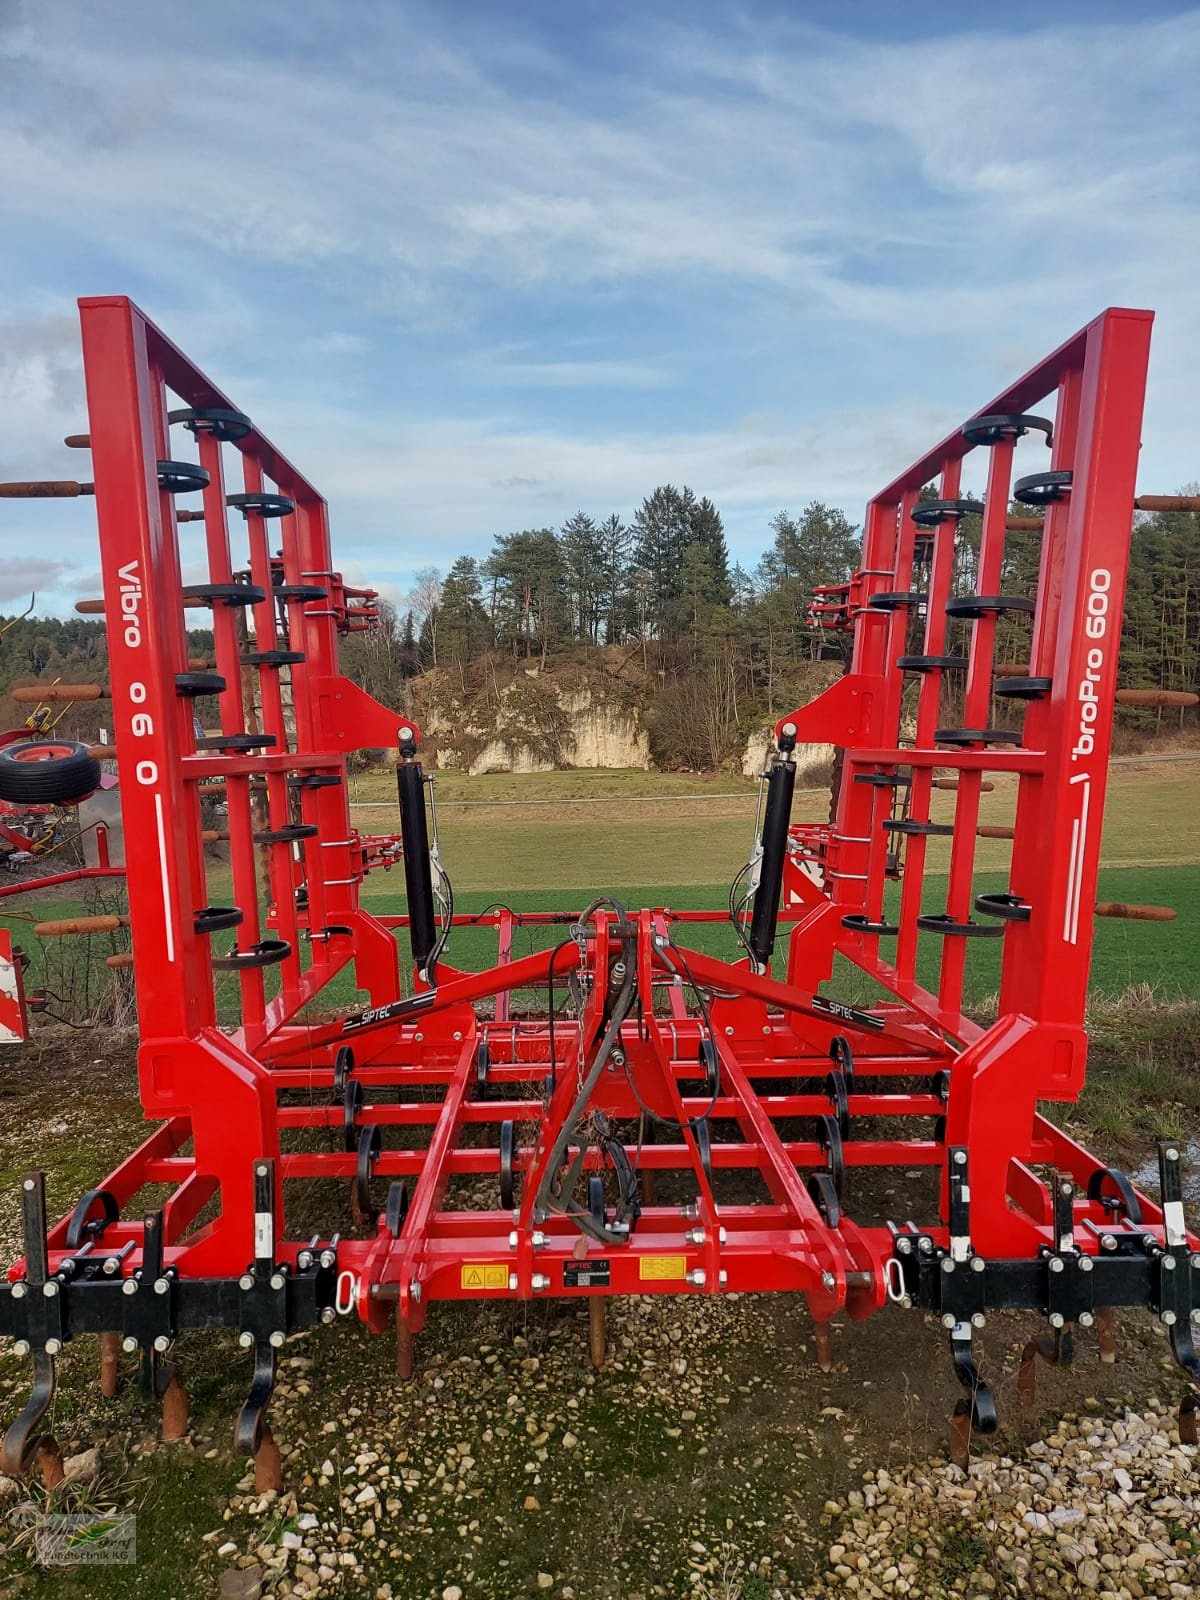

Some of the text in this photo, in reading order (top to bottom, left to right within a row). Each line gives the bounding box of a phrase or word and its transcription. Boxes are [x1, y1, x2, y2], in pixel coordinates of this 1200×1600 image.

[118, 560, 142, 648] Vibro
[1086, 569, 1112, 639] 600
[361, 1004, 392, 1025] SIPTEC
[829, 1002, 854, 1020] SIPTEC
